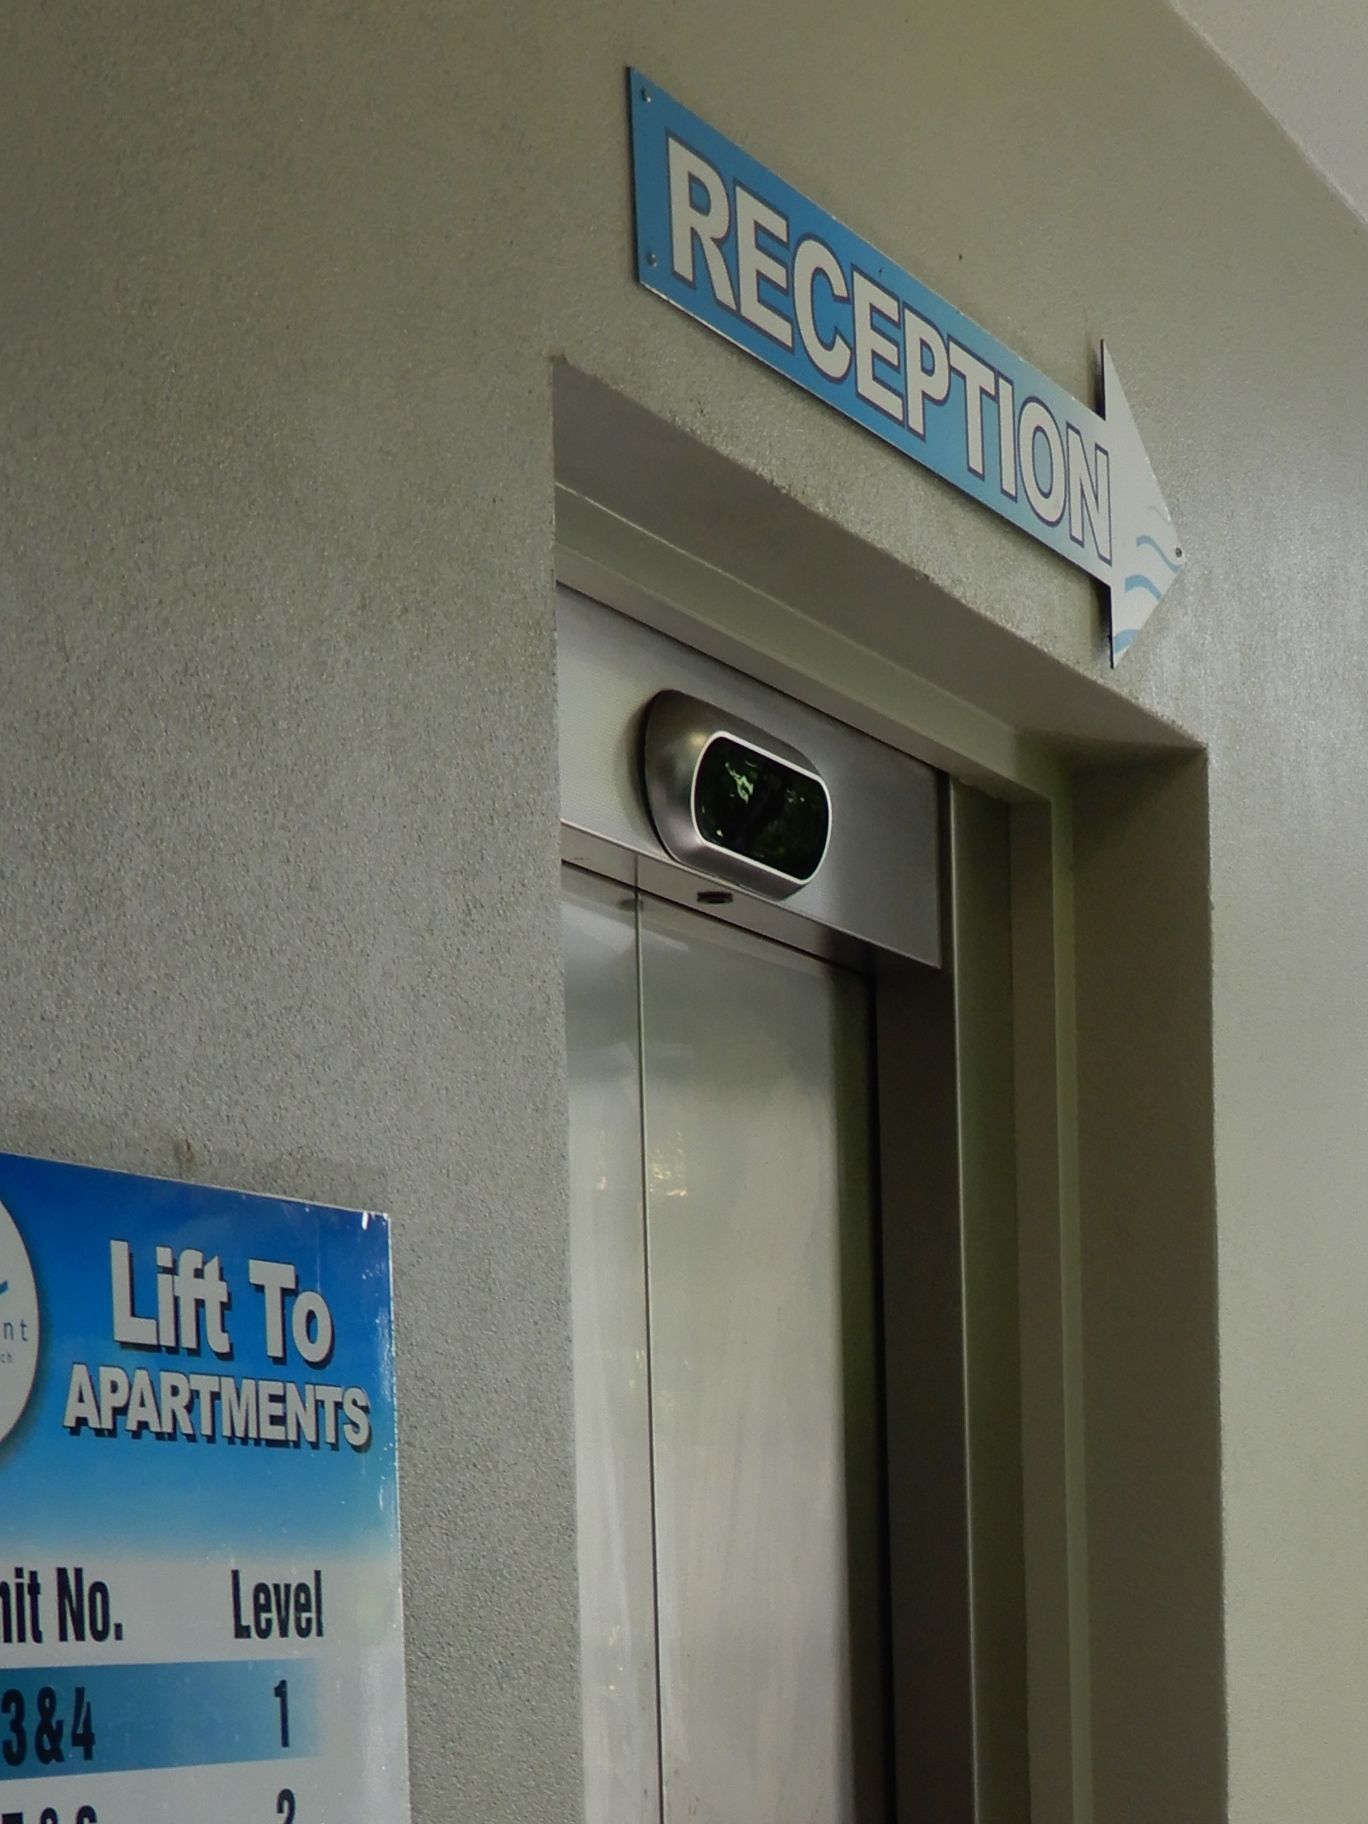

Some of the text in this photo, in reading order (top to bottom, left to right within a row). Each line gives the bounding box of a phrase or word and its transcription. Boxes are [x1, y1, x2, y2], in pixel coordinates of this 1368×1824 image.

[664, 128, 1113, 566] RECEPTION
[110, 1239, 333, 1365] Lift To
[63, 1362, 373, 1450] APARTMENTS
[56, 1566, 123, 1643] No.
[231, 1569, 324, 1640] Level
[273, 1679, 290, 1748] 1
